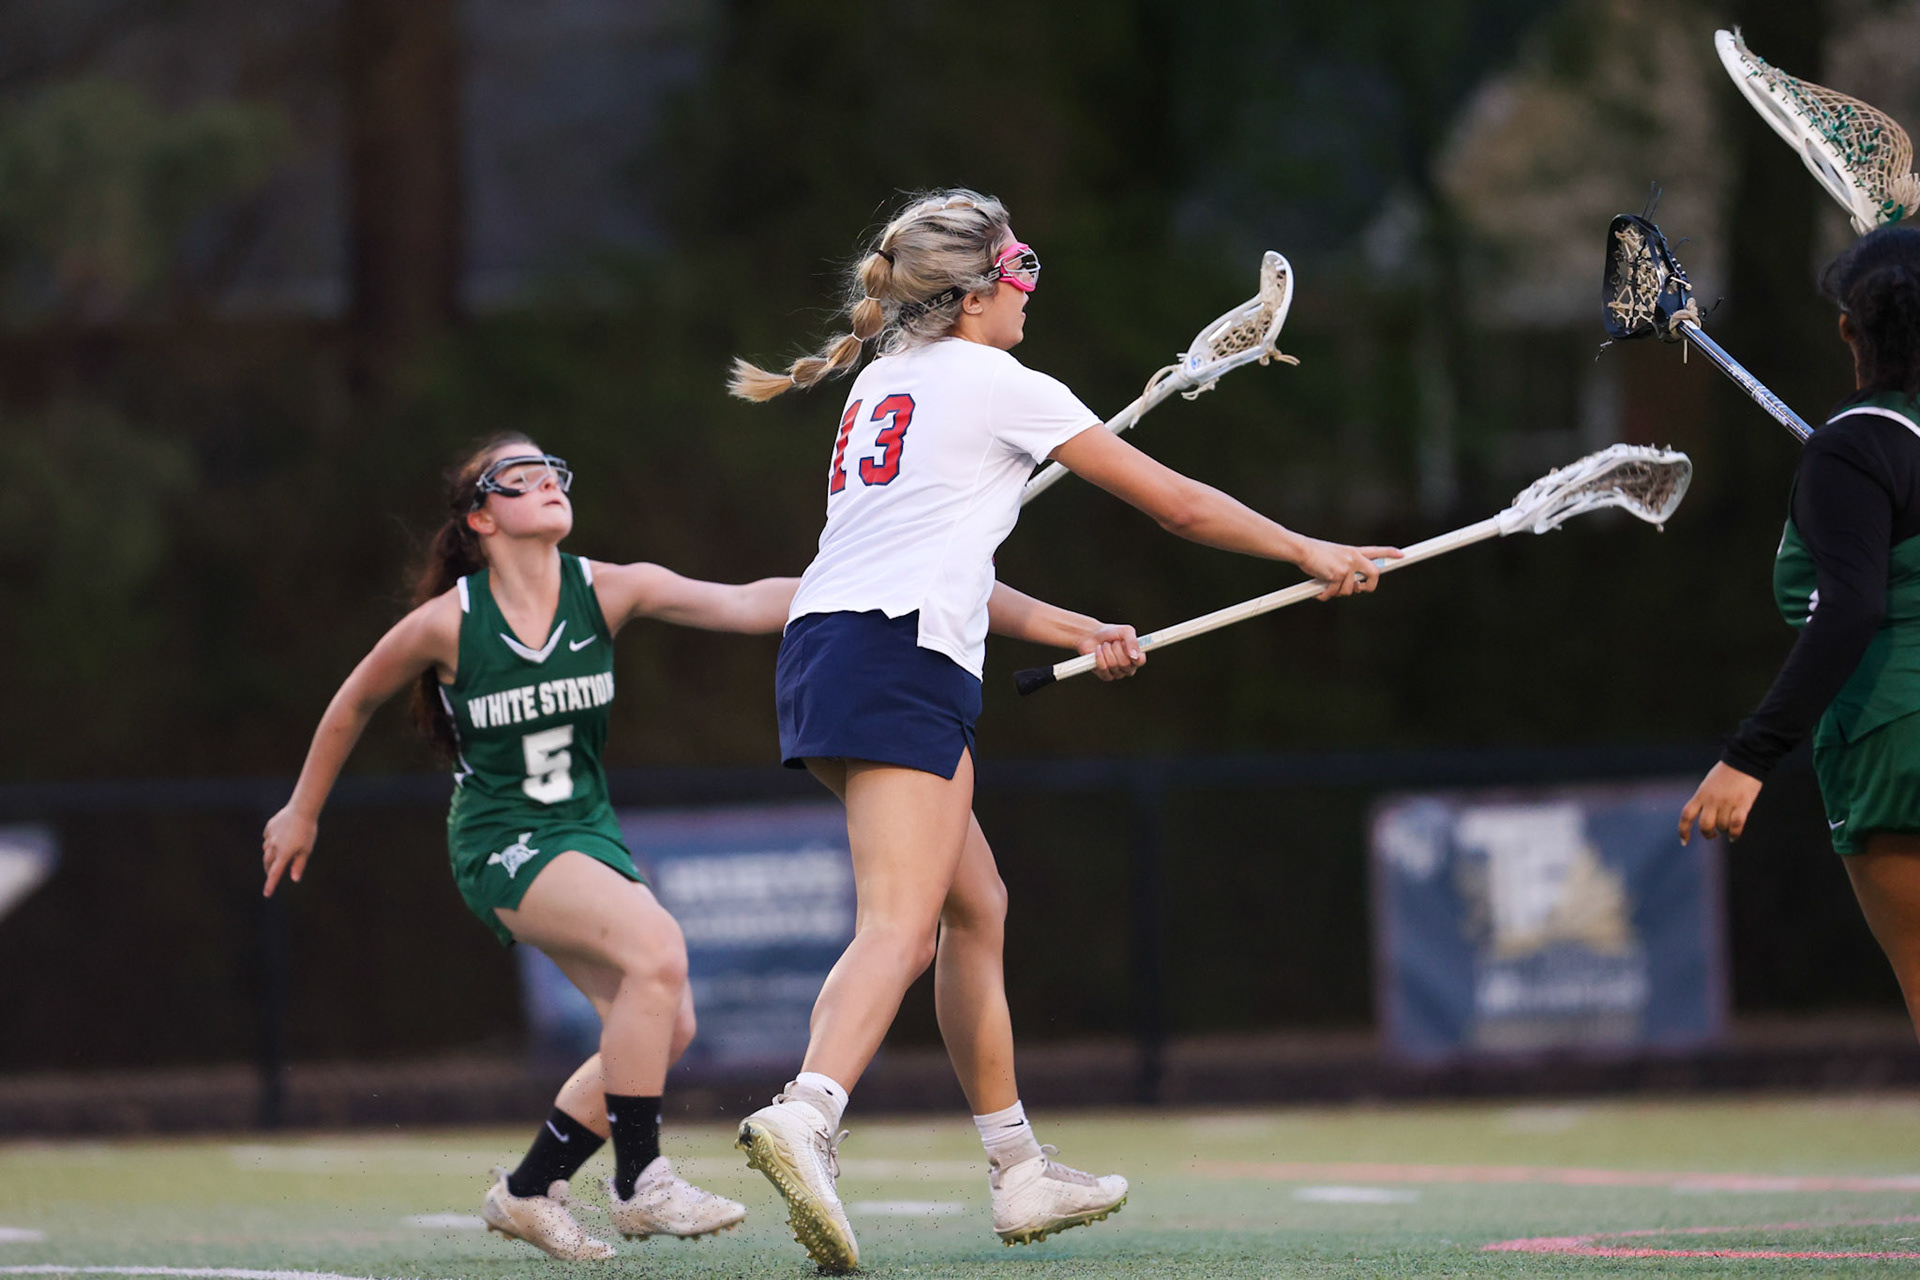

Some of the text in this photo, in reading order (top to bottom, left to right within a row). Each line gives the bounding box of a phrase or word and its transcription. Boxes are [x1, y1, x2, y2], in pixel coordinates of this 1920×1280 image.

[830, 393, 916, 496] 13
[467, 685, 539, 728] WHITE
[522, 724, 574, 804] 5
